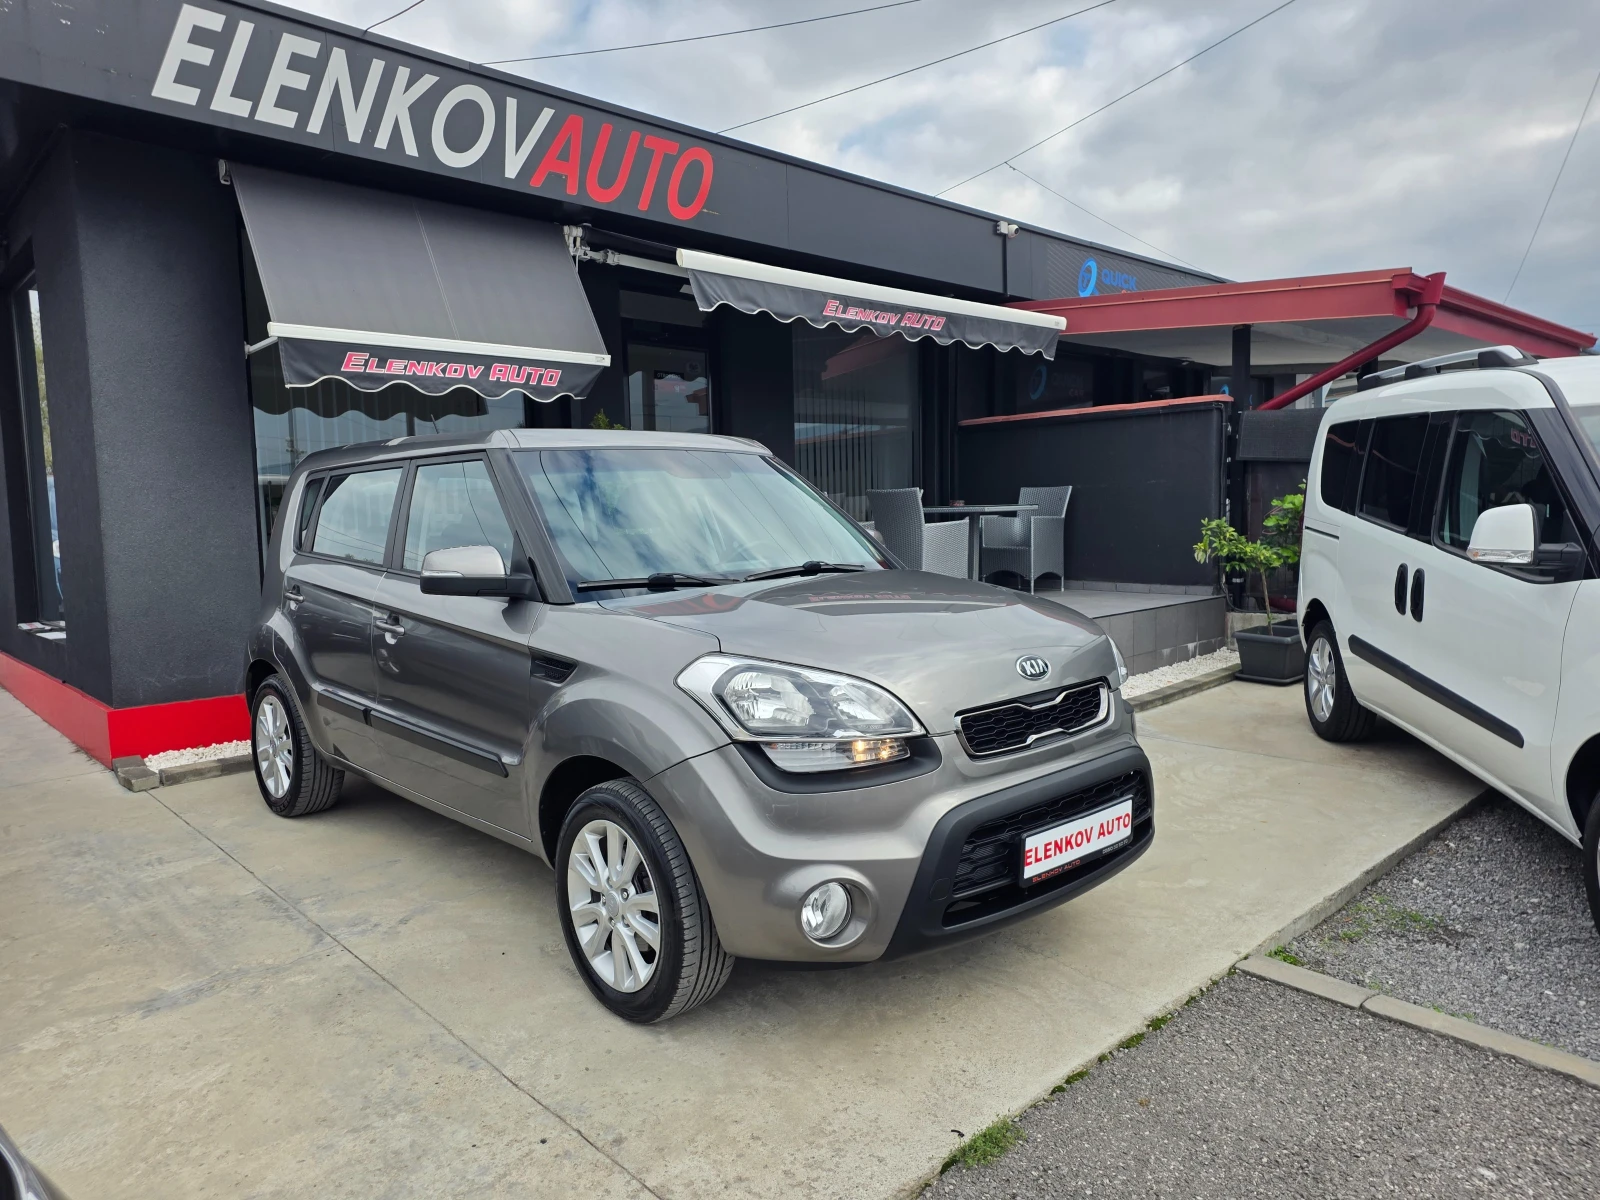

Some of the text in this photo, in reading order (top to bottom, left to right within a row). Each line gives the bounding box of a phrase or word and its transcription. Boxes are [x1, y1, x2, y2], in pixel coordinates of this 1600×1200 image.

[1101, 268, 1137, 291] QUICK
[822, 299, 947, 331] ELENKOV AUTO
[341, 351, 562, 387] ELENKOV AUTO
[1021, 658, 1048, 675] KIA
[1024, 825, 1094, 867] ELENKOV
[1097, 812, 1131, 840] AUTO
